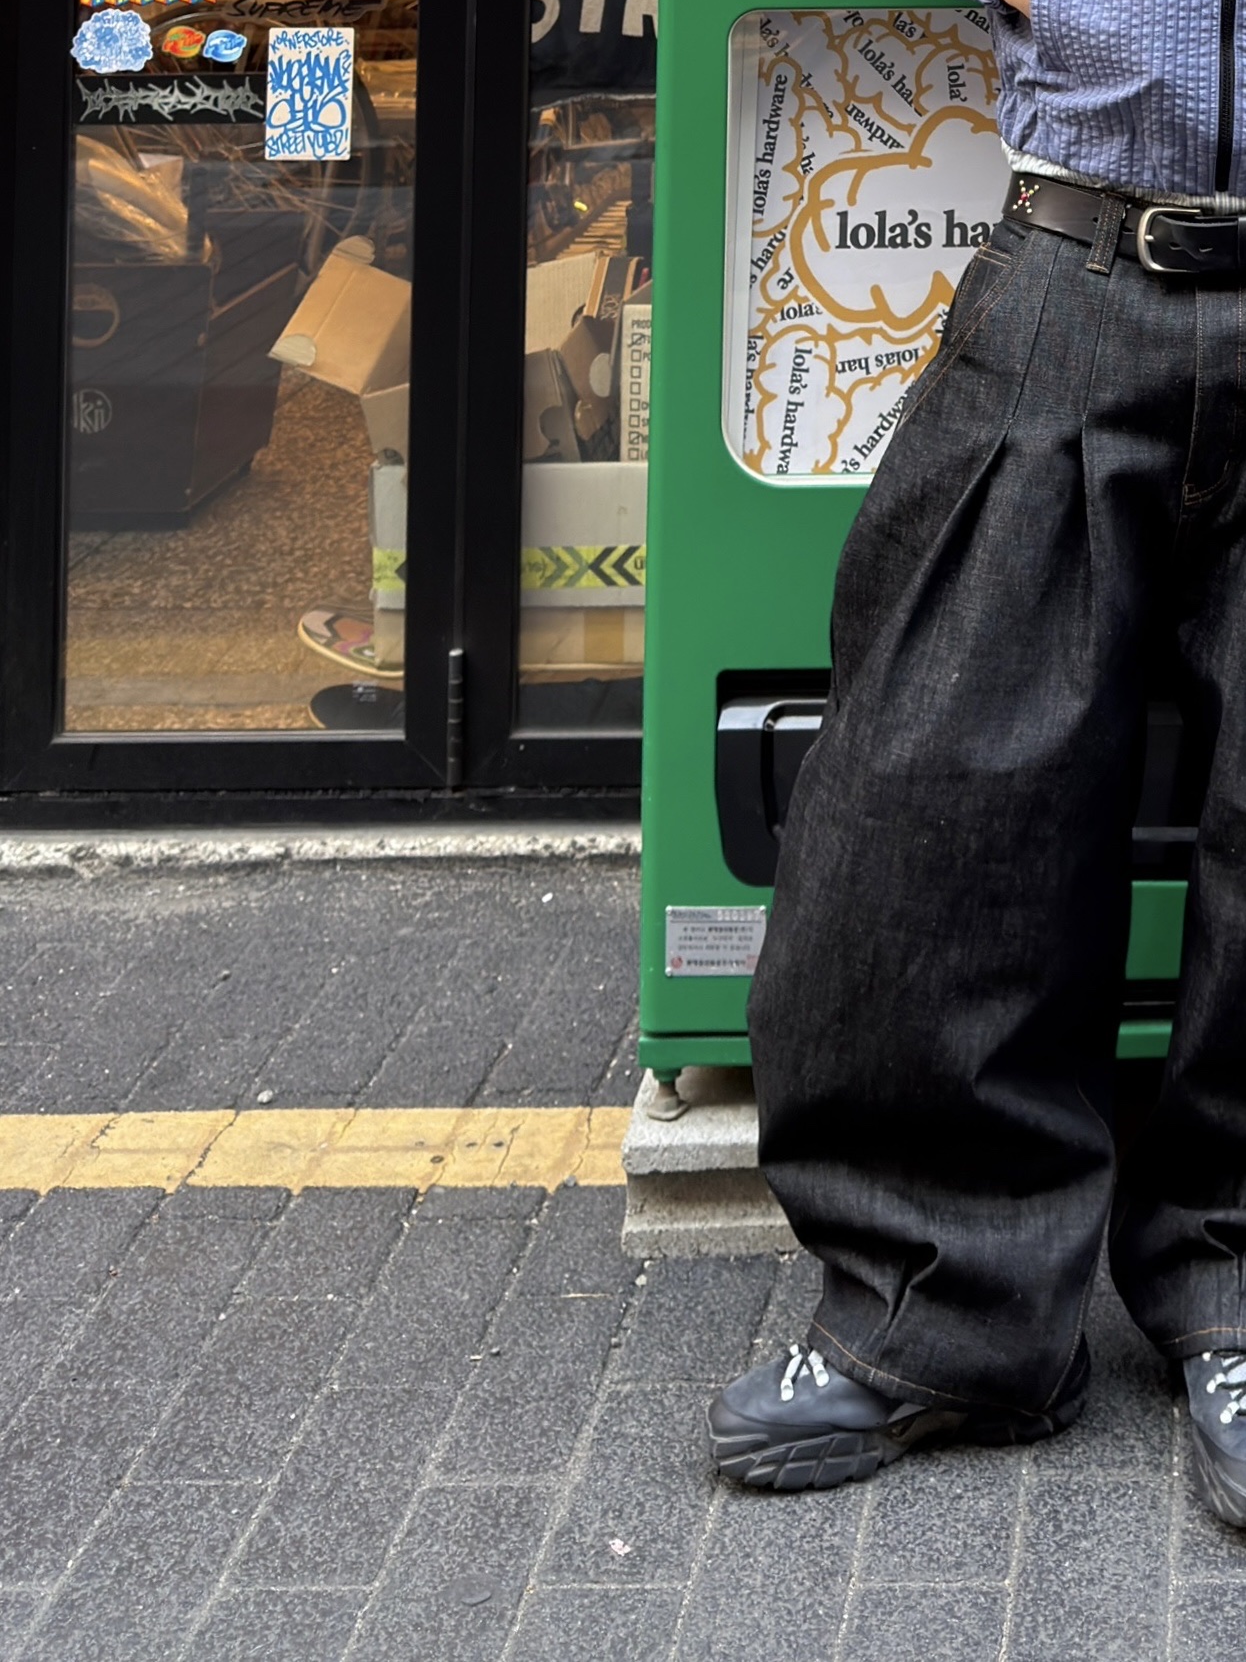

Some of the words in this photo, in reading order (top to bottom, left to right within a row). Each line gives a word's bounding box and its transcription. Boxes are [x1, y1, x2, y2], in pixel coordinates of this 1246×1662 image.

[857, 38, 896, 82] lola's
[756, 73, 788, 166] hardware
[834, 208, 933, 250] lola's
[788, 346, 813, 395] lola's
